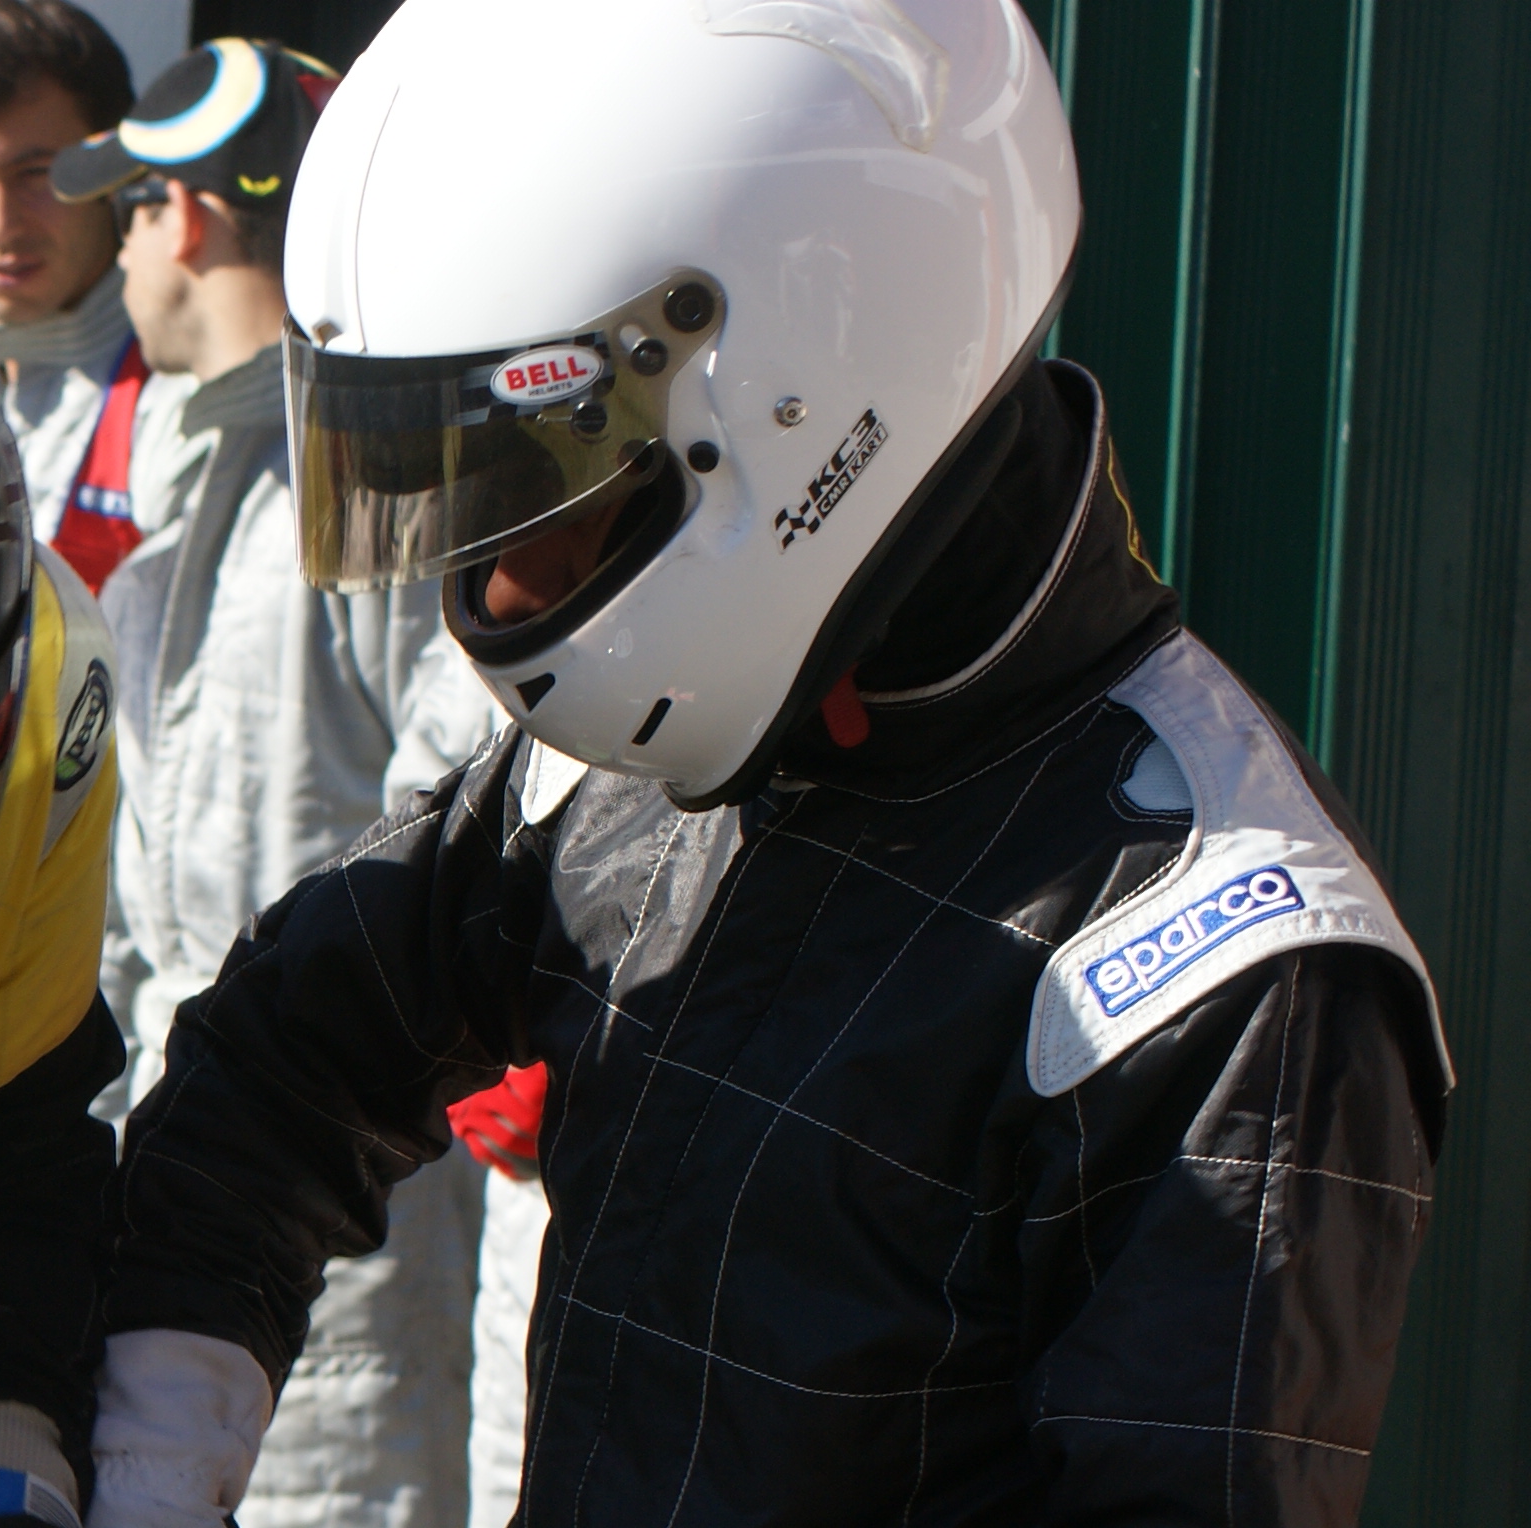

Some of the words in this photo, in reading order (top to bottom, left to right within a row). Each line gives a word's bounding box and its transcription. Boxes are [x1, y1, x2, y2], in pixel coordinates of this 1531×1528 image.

[506, 356, 588, 390] BELL
[807, 408, 877, 503] KC3
[820, 476, 851, 513] CMR
[850, 430, 884, 475] KART
[1093, 869, 1290, 992] sparco
